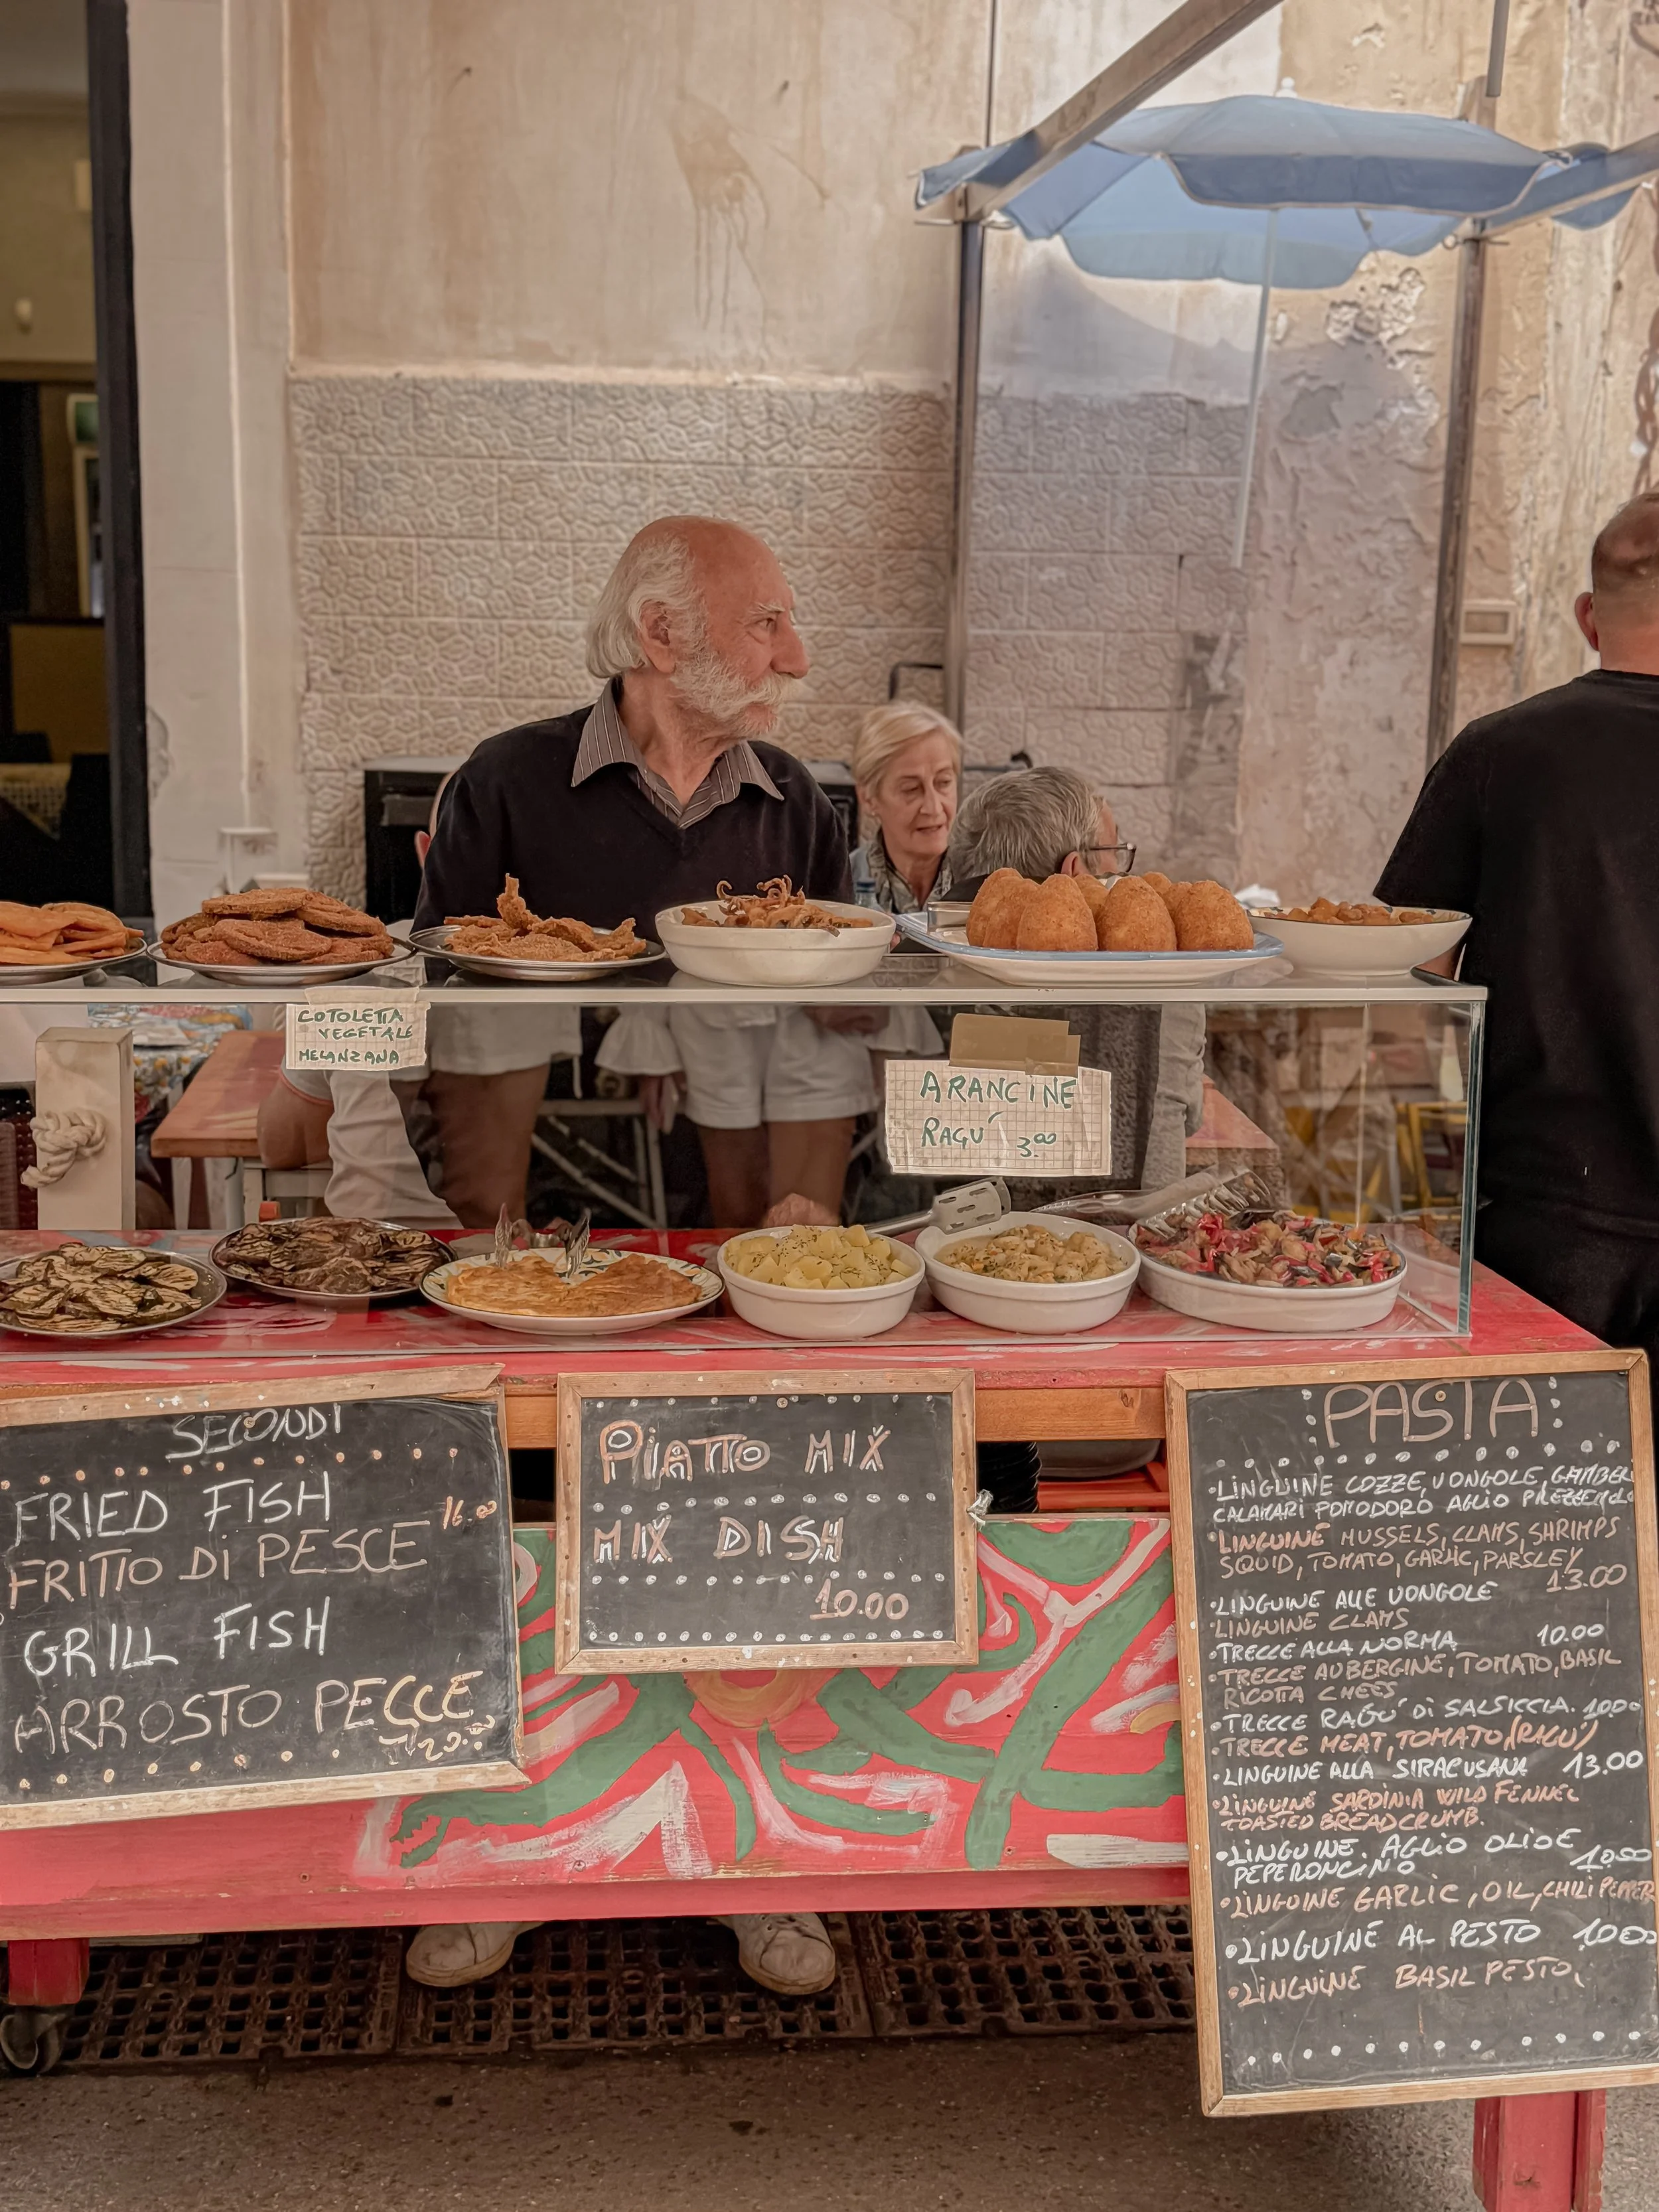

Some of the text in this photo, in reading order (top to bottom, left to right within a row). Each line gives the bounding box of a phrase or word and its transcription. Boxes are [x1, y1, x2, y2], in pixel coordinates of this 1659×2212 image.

[297, 1007, 404, 1025] COTOLETTA
[318, 1025, 413, 1041] VEGETALE
[299, 1048, 399, 1065] MELANZANA
[920, 1070, 1078, 1110] ARANCINE
[1323, 1377, 1539, 1448] PASTA
[165, 1402, 342, 1459] SECONDI
[804, 1424, 891, 1474] MIX
[15, 1471, 331, 1547] FRIED FISH
[1315, 1499, 1435, 1520] POMODORO
[594, 1514, 845, 1564] MIX DISH
[1528, 1515, 1621, 1546] SHRIMPS
[8, 1548, 163, 1610] FRITTO
[259, 1520, 431, 1578] PESCE
[1482, 1546, 1583, 1574] PARSLEY
[1546, 1563, 1627, 1593] 13.00
[810, 1578, 909, 1621] 10.00
[1214, 1580, 1499, 1615] LINGUINE ALLE VONGOLE
[24, 1595, 330, 1678] GRILL FISH
[1214, 1607, 1409, 1639] LINGUINE CLAMS
[1536, 1624, 1605, 1647] 10.00
[1216, 1630, 1458, 1664] TRECCE ALLA NORMA
[1217, 1664, 1307, 1690] TRECCE
[1559, 1648, 1623, 1670] BASIL
[1224, 1681, 1398, 1710] RICOTTA CHEES
[15, 1684, 283, 1754] ARROSTO
[1222, 1712, 1309, 1733] TRECCE
[1219, 1734, 1309, 1758] TRECCE
[1222, 1749, 1644, 1786] LINGUINE ALLA SIRACUSANA 13.00
[1436, 1785, 1487, 1806] WILD
[1494, 1779, 1580, 1804] FENNEL
[1397, 1923, 1436, 1951] AL
[1449, 1919, 1542, 1949] PESTO
[1395, 1964, 1476, 1990] BASIL
